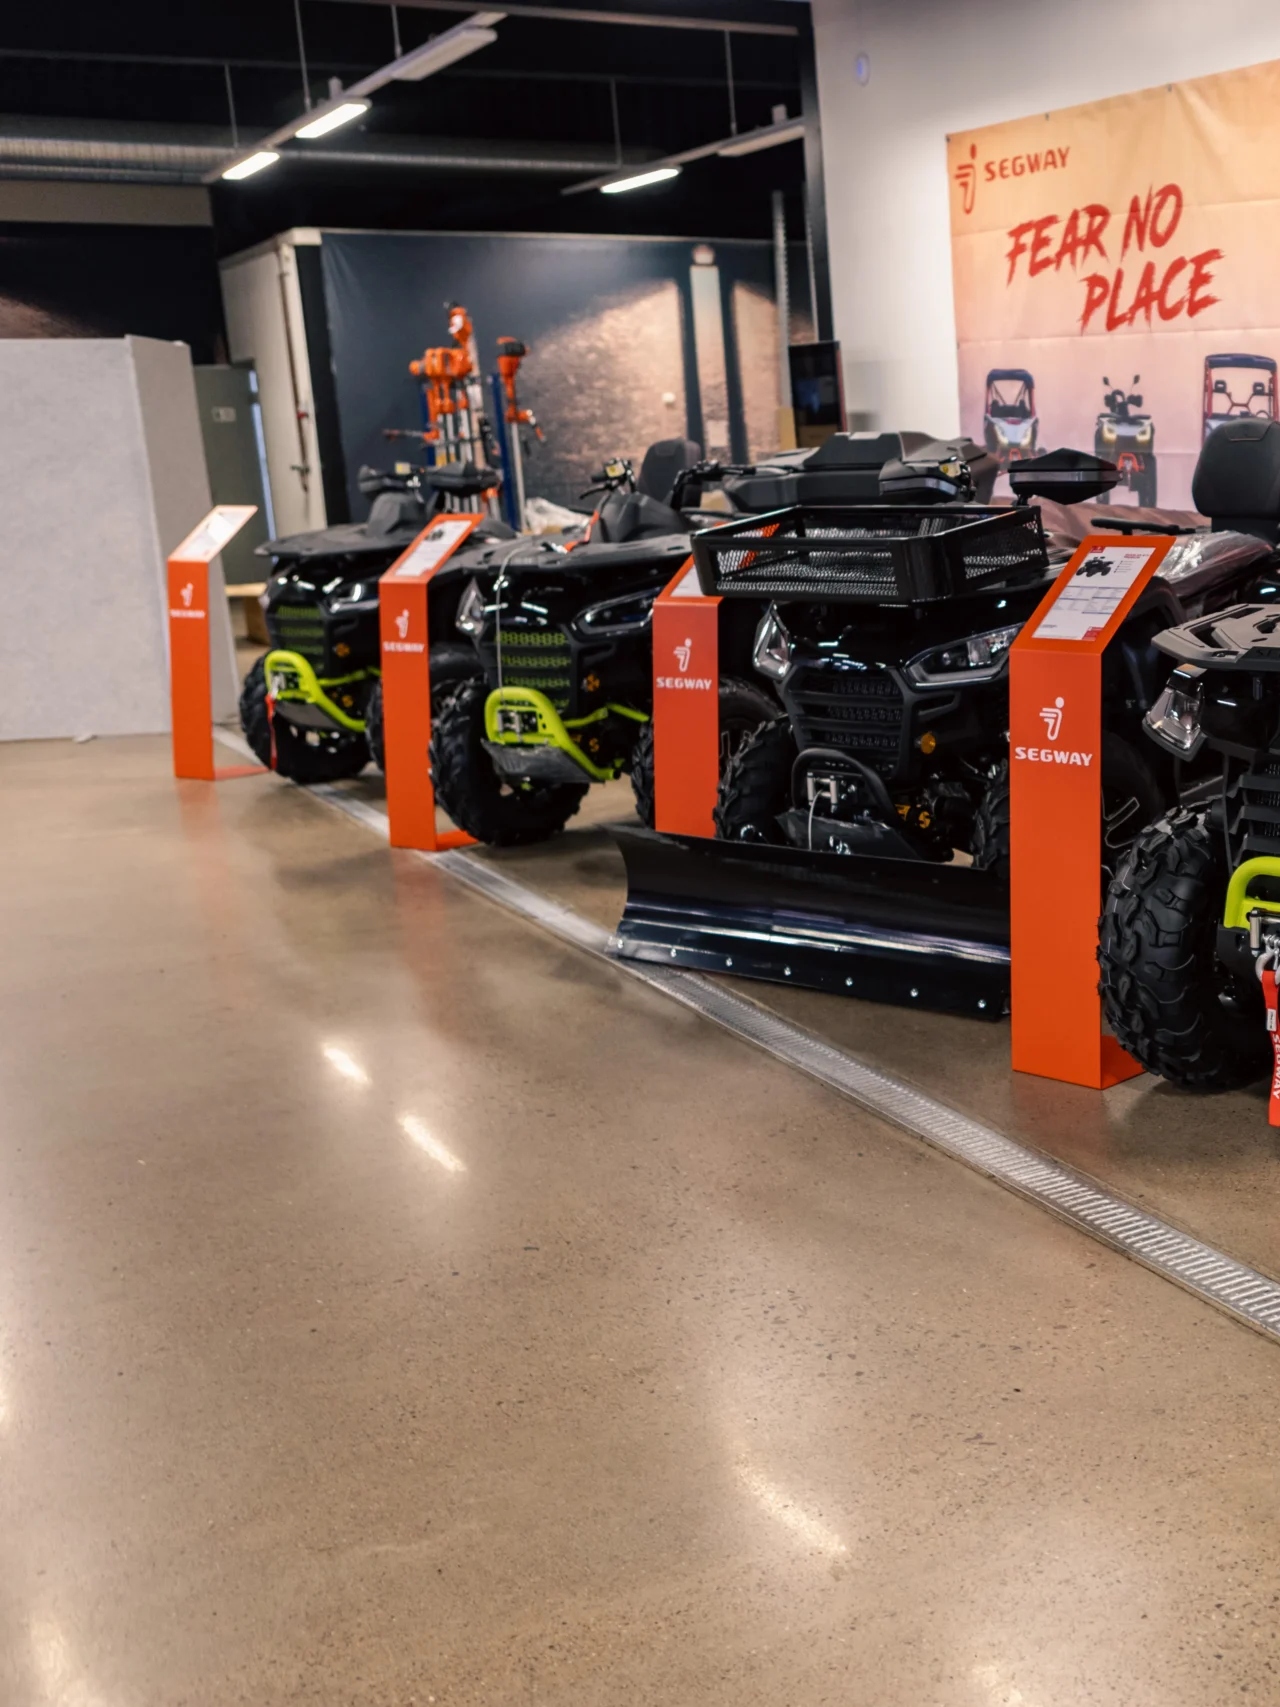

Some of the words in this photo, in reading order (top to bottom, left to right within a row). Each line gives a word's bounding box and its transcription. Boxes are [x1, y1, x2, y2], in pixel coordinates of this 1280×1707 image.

[983, 146, 1070, 182] SEGWAY
[1005, 203, 1110, 287] FEAR
[1120, 182, 1184, 264] NO
[1077, 248, 1225, 336] PLACE
[655, 676, 712, 691] SEGWAY
[1015, 747, 1093, 766] SEGWAY
